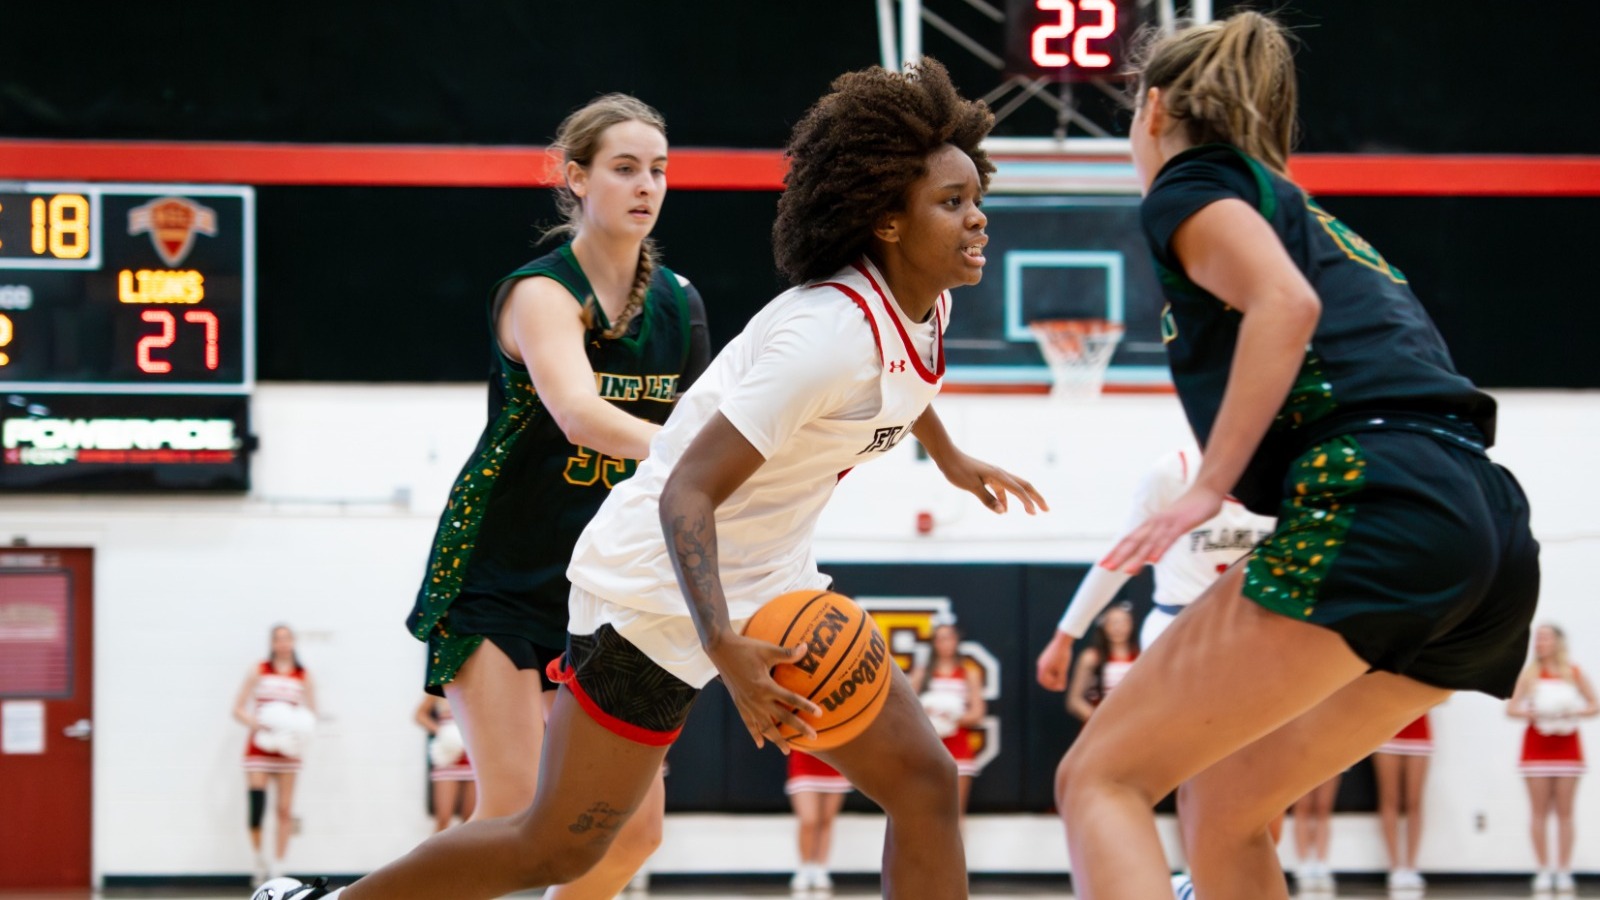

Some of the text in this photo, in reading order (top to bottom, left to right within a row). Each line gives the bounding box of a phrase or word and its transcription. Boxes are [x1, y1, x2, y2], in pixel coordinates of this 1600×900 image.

[1031, 0, 1116, 67] 22
[136, 310, 219, 373] 27
[594, 372, 680, 402] INT LE
[793, 605, 850, 676] NCAA
[818, 628, 887, 713] Wilson
